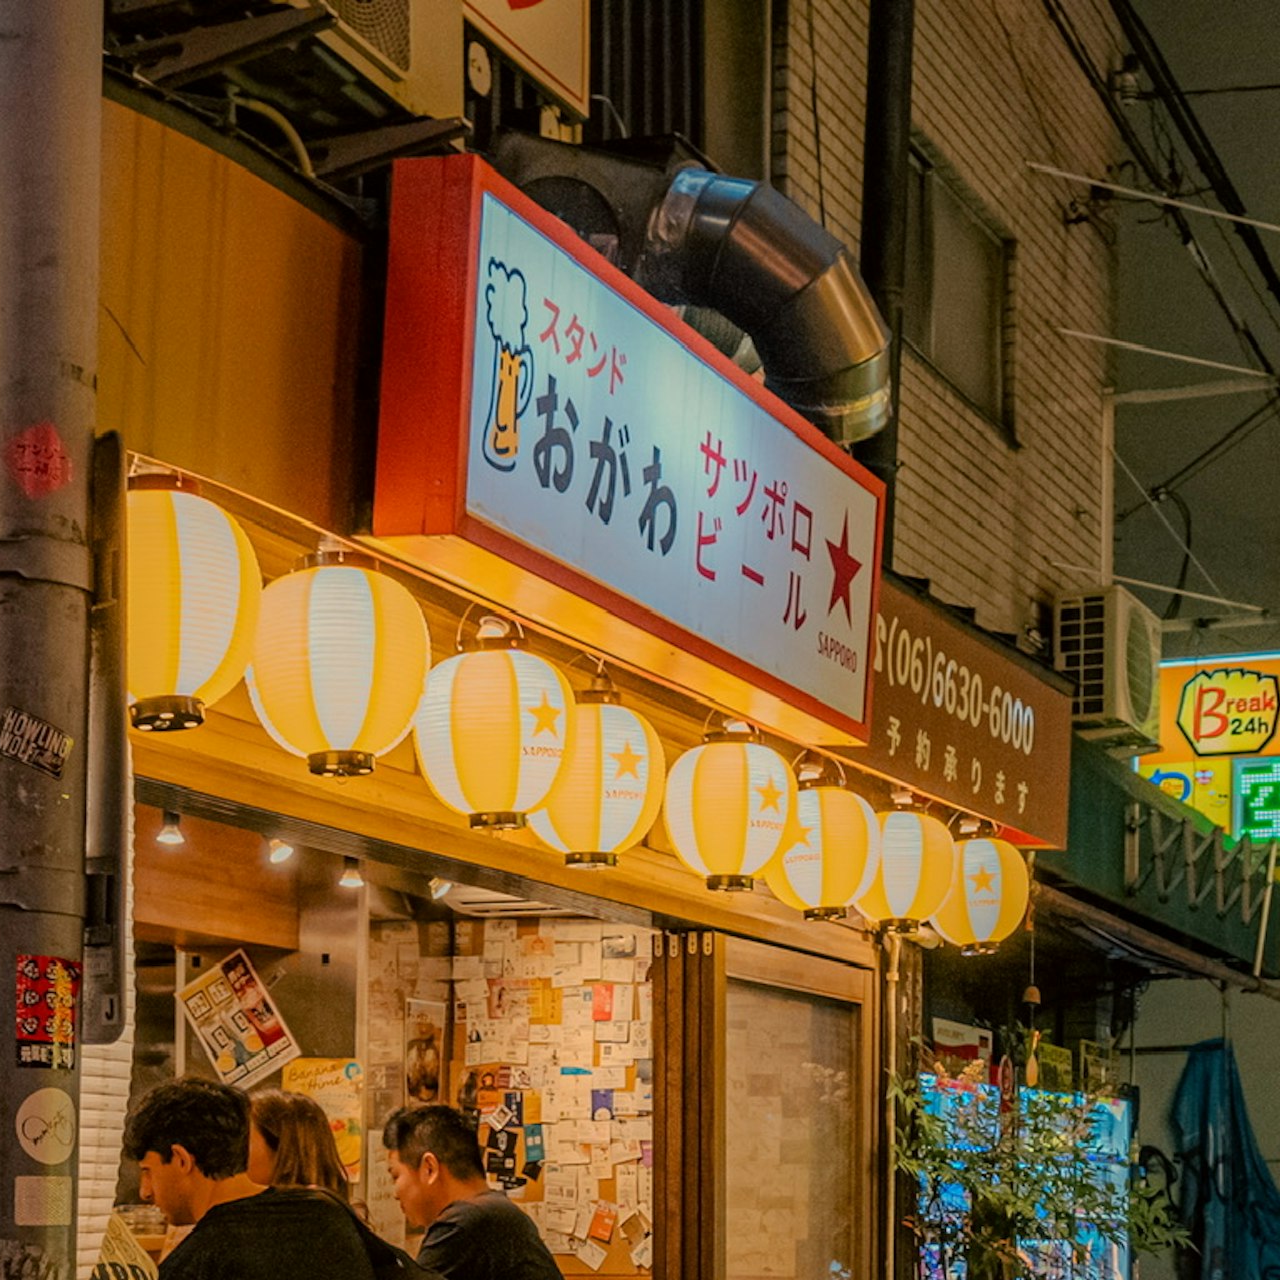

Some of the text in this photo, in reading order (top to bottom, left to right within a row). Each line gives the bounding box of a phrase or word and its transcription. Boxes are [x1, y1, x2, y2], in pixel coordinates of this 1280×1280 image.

[539, 297, 627, 395] スタンド
[533, 373, 678, 556] おがわ
[695, 510, 807, 632] ビール
[817, 630, 858, 675] SAPPORO
[1193, 684, 1277, 743] Break
[1230, 718, 1269, 736] 24h
[886, 716, 1029, 815] 予約承ります
